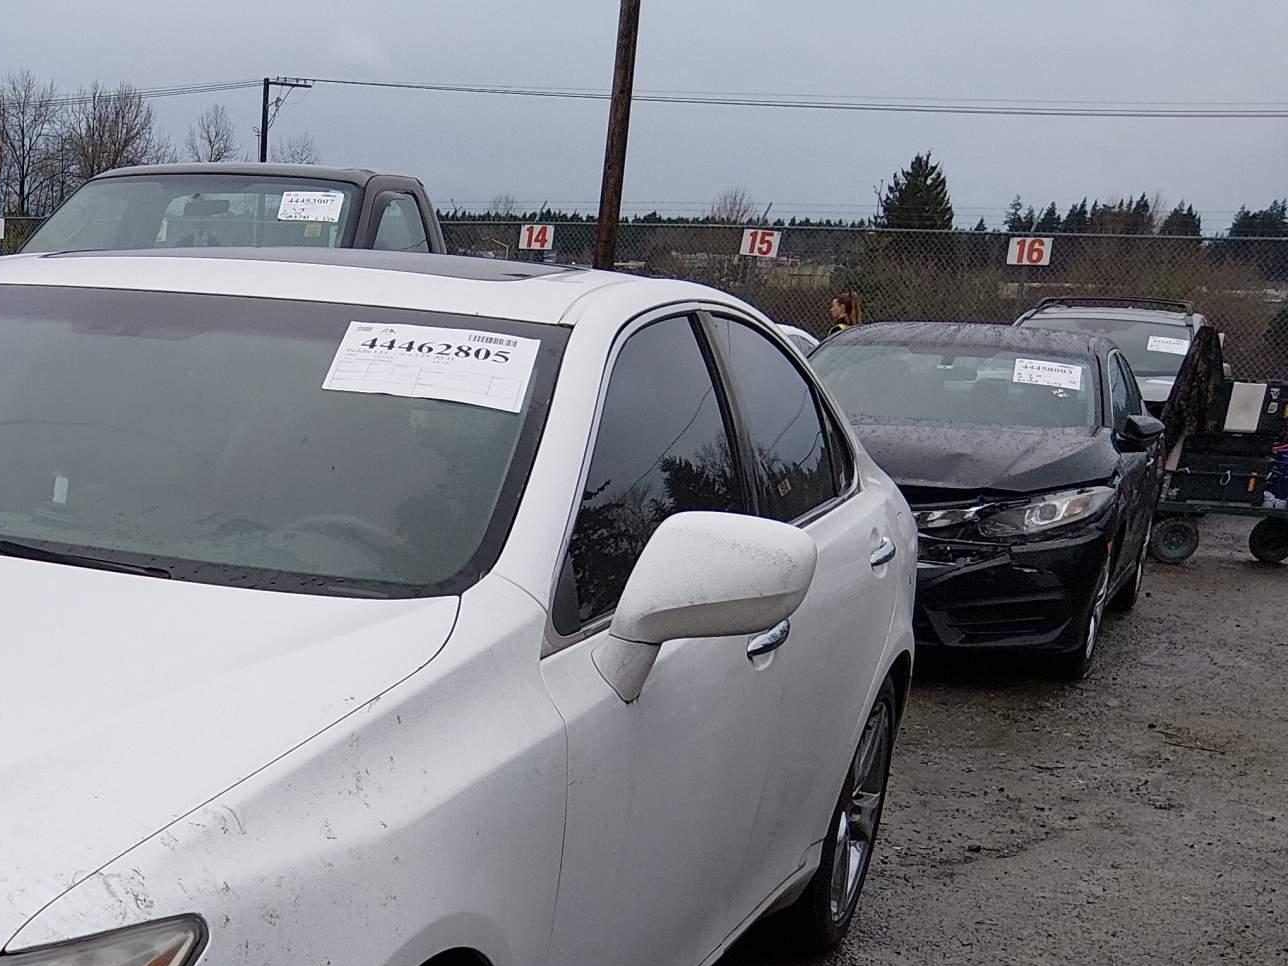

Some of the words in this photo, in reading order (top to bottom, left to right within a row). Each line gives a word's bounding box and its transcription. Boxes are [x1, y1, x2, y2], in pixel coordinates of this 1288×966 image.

[525, 225, 548, 248] 14
[749, 230, 775, 256] 15
[1016, 238, 1045, 264] 16
[360, 336, 512, 364] 44462805
